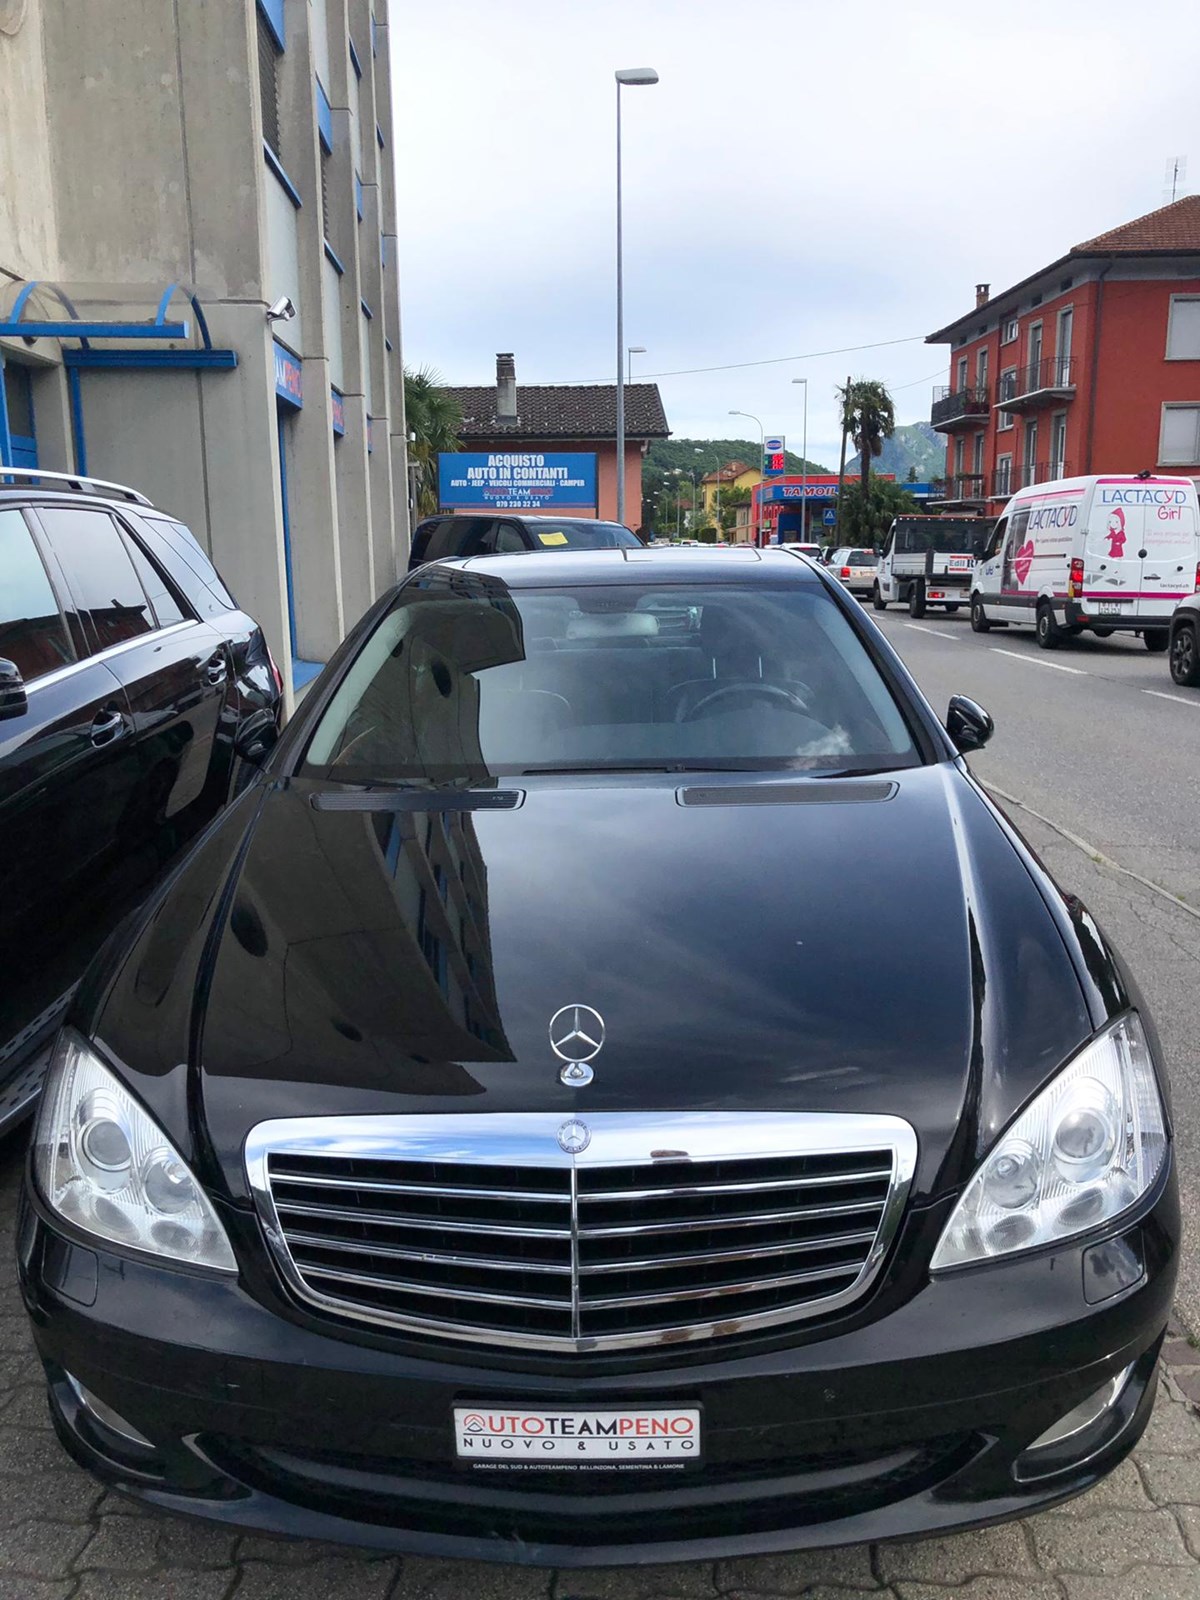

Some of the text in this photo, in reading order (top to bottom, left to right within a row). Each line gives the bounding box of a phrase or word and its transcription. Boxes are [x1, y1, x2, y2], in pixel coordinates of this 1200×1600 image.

[488, 455, 544, 467] ACQUISTO
[467, 467, 567, 479] AUTO IN CONTANTI
[783, 487, 839, 497] TAMOIL
[1102, 489, 1187, 504] LACTACYD
[1028, 505, 1078, 530] LACTACYD
[1157, 505, 1182, 520] Girl
[463, 1438, 694, 1450] NUOVO & USATO
